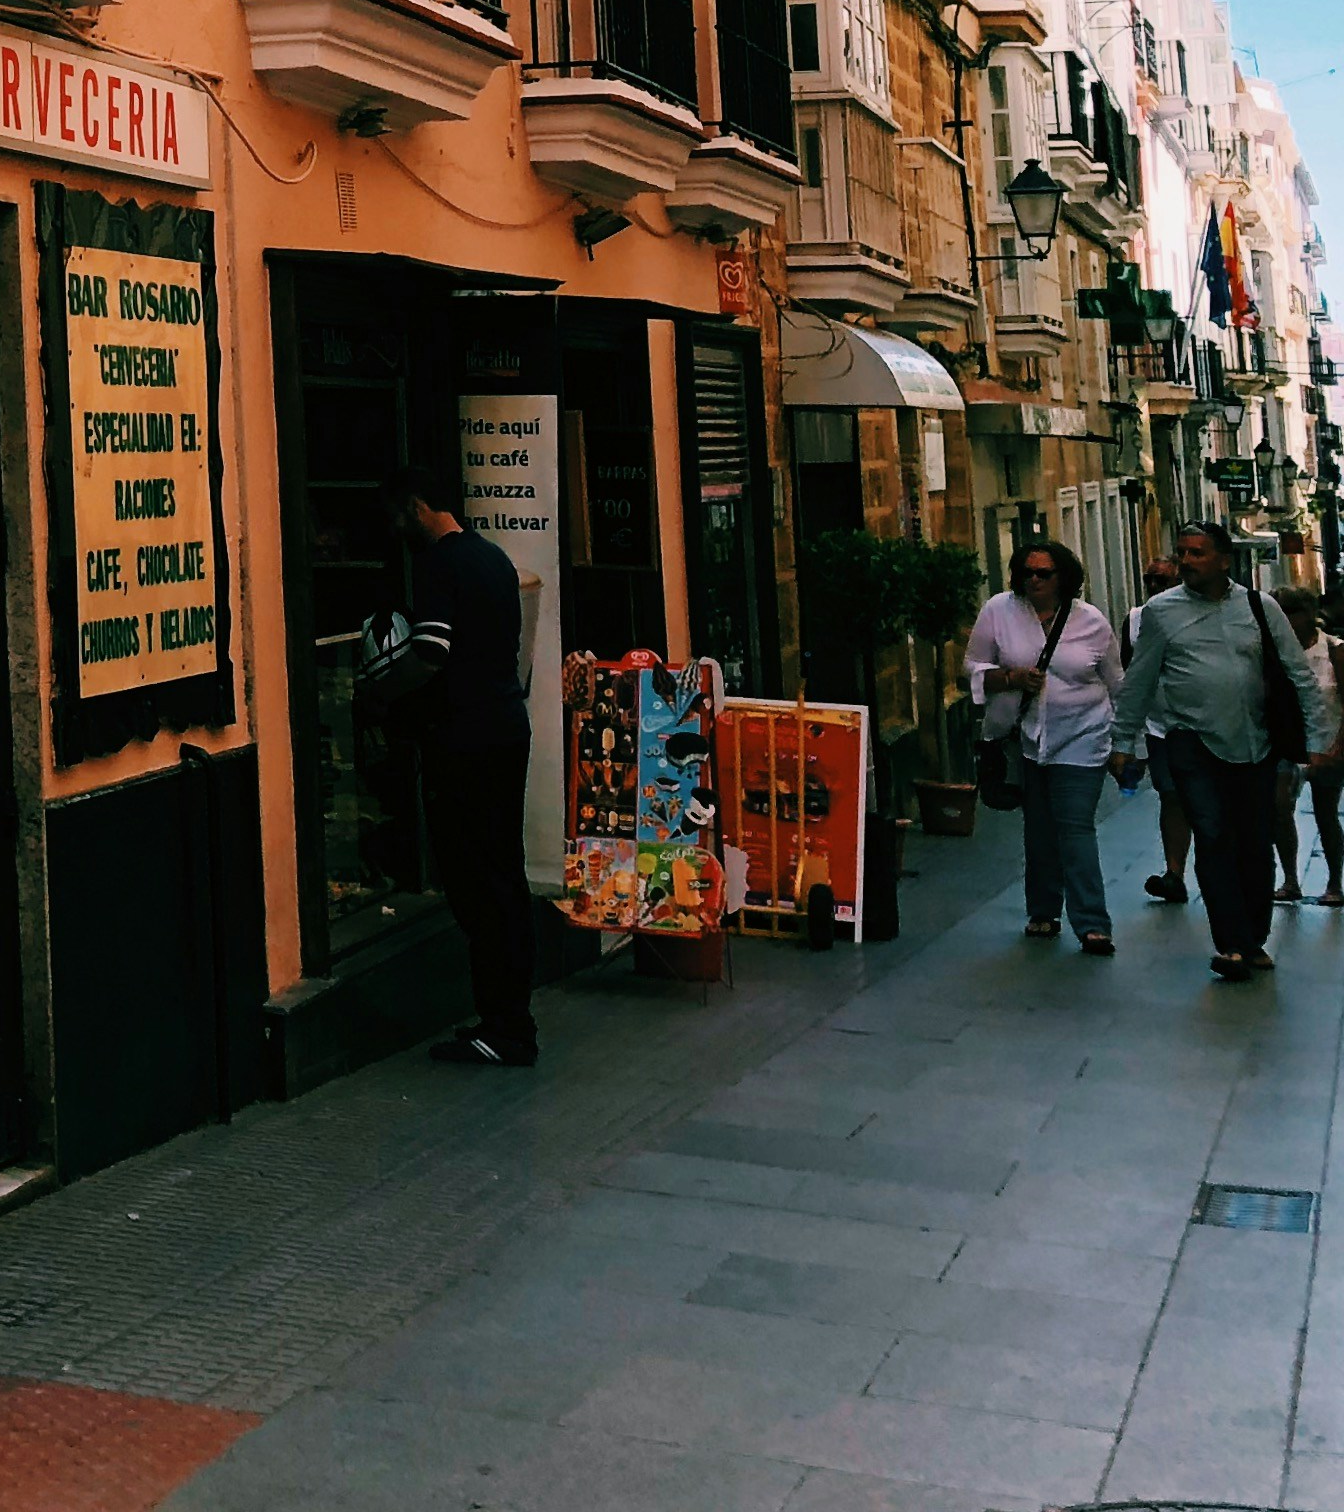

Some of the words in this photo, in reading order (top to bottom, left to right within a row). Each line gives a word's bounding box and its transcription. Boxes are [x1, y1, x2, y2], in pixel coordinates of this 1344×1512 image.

[68, 271, 109, 319] BAR
[119, 276, 201, 327] ROSARIO
[84, 411, 174, 456] ESPECIALIDAD
[180, 412, 202, 453] EN:
[458, 419, 495, 435] Pide
[499, 418, 541, 439] aquí
[467, 451, 485, 467] tu
[490, 450, 529, 467] café
[115, 478, 176, 522] RACIONES
[464, 482, 535, 499] Lavazza
[463, 515, 490, 530] ara
[494, 513, 550, 531] llevar
[137, 540, 206, 588] CHOCOLATE
[81, 613, 141, 666] CHURROS
[146, 614, 155, 653] Y
[161, 603, 214, 653] HELADOS
